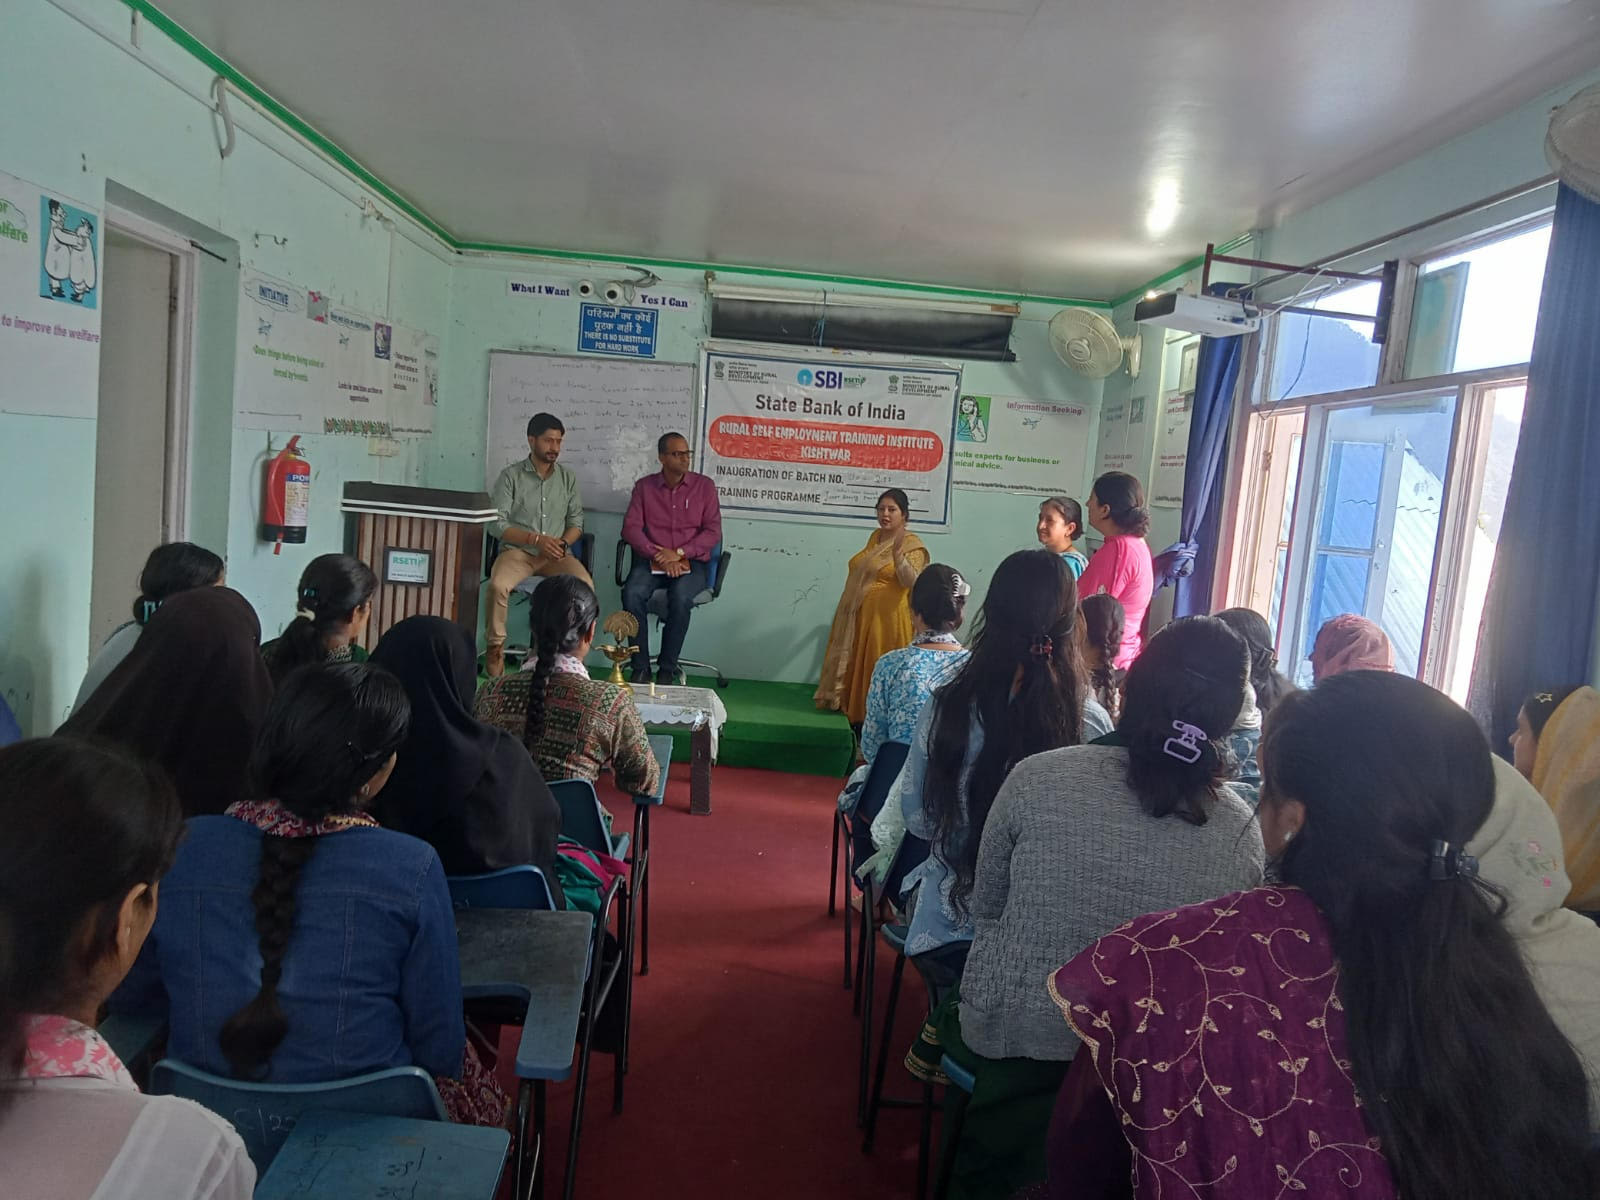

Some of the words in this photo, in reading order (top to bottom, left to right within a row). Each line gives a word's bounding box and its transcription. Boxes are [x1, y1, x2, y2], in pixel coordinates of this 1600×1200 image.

[511, 282, 537, 294] What
[538, 284, 543, 294] I
[545, 286, 570, 296] Want
[641, 294, 659, 304] Yes
[661, 296, 666, 305] I
[668, 297, 688, 308] Can
[2, 315, 12, 327] to
[14, 316, 52, 333] improve
[54, 324, 67, 336] the
[584, 331, 602, 340] THERE
[618, 334, 651, 344] SUBSTITUTE
[595, 341, 606, 349] FOR
[607, 342, 622, 351] HARD
[623, 345, 639, 353] WORK
[814, 370, 842, 390] SBI
[755, 394, 796, 413] State
[803, 398, 842, 417] Bank
[850, 402, 862, 418] of
[868, 404, 906, 420] India
[1007, 402, 1050, 413] Information
[1052, 406, 1083, 416] Seeking
[720, 422, 750, 437] RURAL
[752, 425, 774, 438] SELF
[775, 426, 838, 443] EMPLOYMENT
[840, 432, 884, 446] TRAINING
[886, 435, 934, 450] INSTITUTE
[801, 446, 851, 462] KISHTWAR
[974, 453, 1003, 462] experts
[1017, 455, 1050, 465] business
[976, 461, 1003, 470] advice.
[716, 465, 780, 480] INAUGRATION
[782, 470, 793, 481] OF
[796, 471, 826, 484] BATCH
[828, 474, 844, 484] NO.
[716, 486, 758, 500] TRAINING
[761, 489, 821, 504] PROGRAMME
